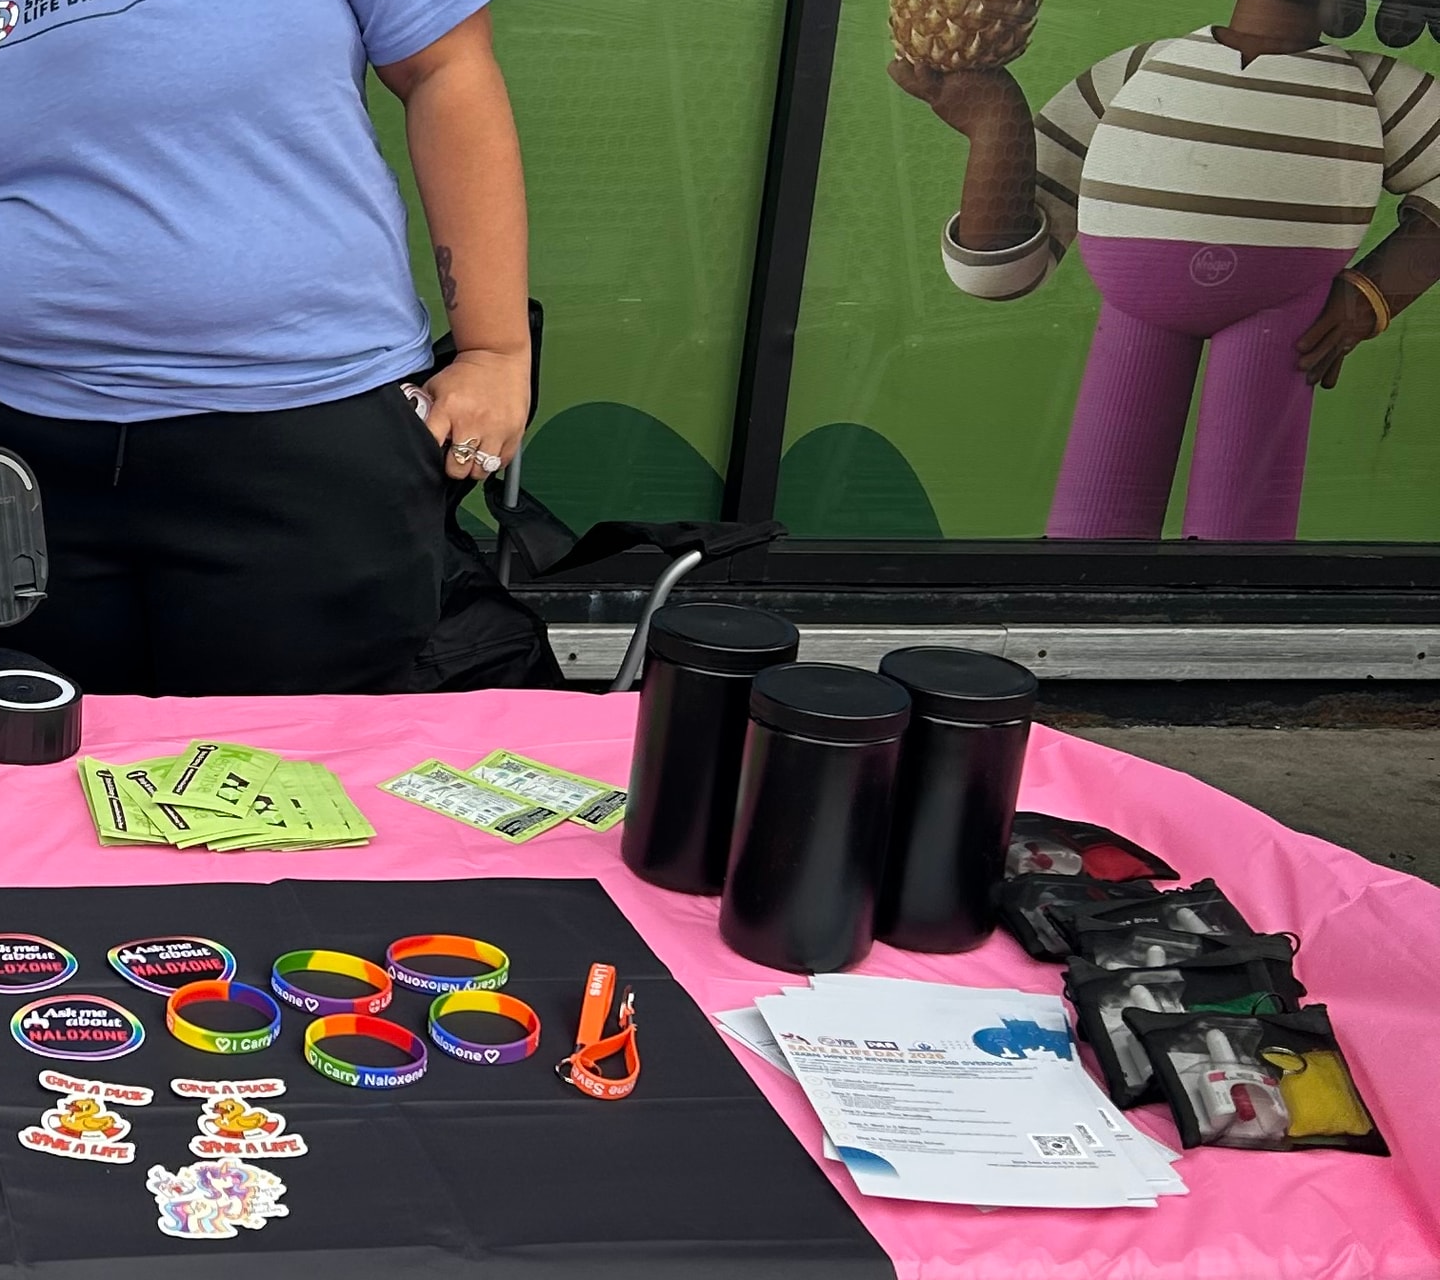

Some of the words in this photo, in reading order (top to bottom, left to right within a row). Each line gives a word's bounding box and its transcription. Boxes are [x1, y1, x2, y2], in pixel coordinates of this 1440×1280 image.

[23, 0, 60, 24] LIFE
[13, 945, 40, 953] me
[136, 945, 165, 954] Ask
[166, 943, 193, 951] me
[159, 948, 212, 960] about
[1, 952, 56, 961] about
[131, 958, 224, 976] NALOXONE
[43, 1008, 77, 1018] Ask
[79, 1009, 108, 1018] me
[66, 1017, 122, 1028] about
[29, 1029, 128, 1041] NALOXONE
[241, 1033, 273, 1051] Carry
[787, 1044, 825, 1053] SAVE
[874, 1050, 905, 1058] DAY
[324, 1062, 361, 1086] Carry
[364, 1068, 423, 1086] Naloxone
